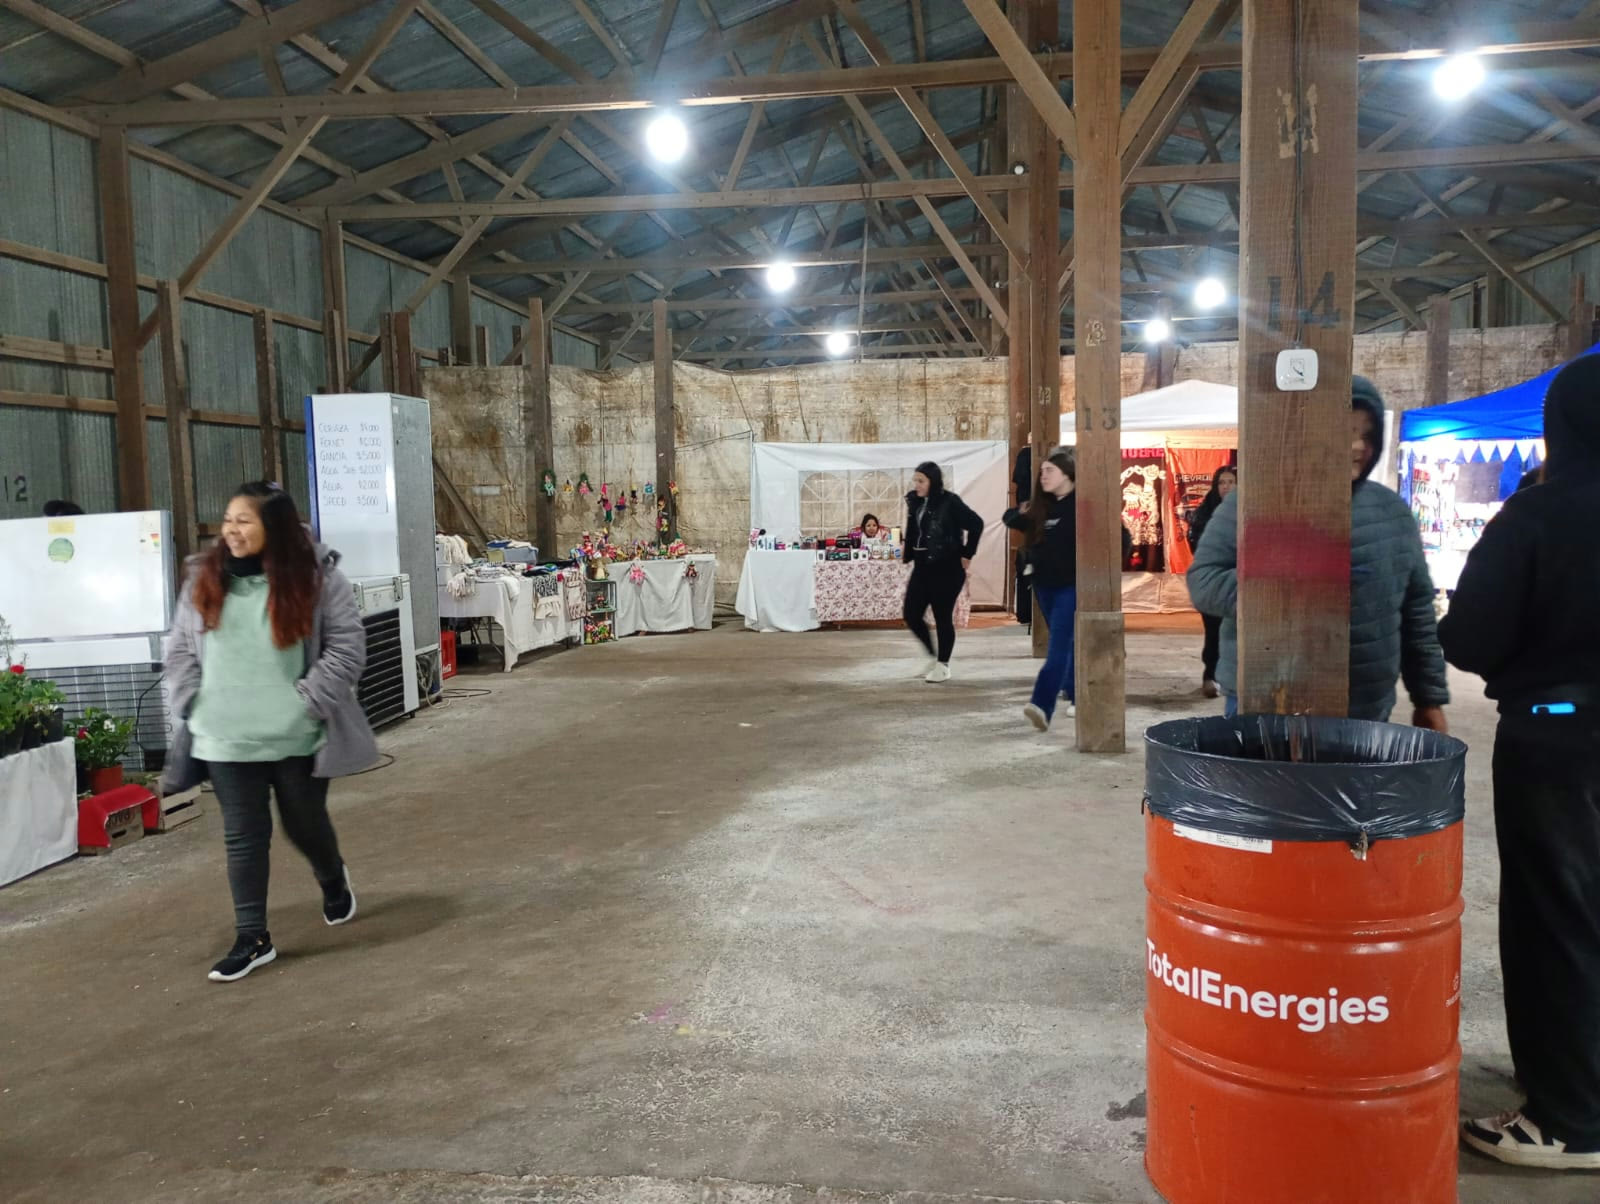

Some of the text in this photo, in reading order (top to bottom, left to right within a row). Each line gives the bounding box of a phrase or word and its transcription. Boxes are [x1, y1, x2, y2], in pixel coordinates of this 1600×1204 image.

[1267, 271, 1341, 333] 14
[1083, 407, 1118, 431] 13
[4, 475, 28, 502] 12
[1146, 937, 1389, 1033] TotalEnergies
